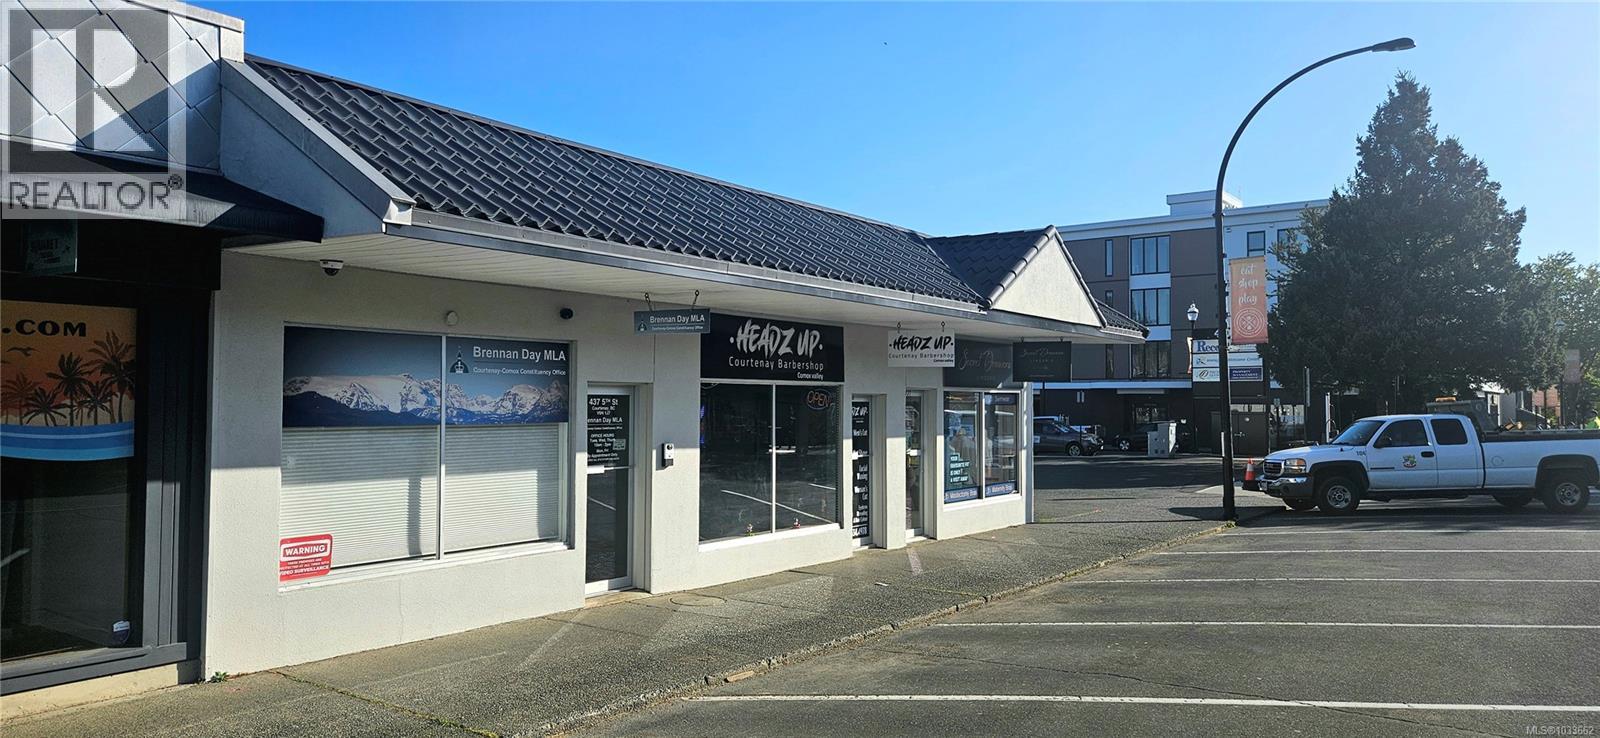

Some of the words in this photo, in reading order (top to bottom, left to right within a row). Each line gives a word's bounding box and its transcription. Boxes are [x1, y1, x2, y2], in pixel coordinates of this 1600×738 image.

[676, 315, 690, 324] Day
[797, 328, 821, 359] UP
[933, 335, 952, 350] UP
[472, 345, 519, 360] Brennan
[521, 348, 541, 363] Day
[543, 349, 566, 361] MLA
[728, 356, 775, 371] Courtenay
[777, 358, 824, 371] Barbershop
[472, 366, 519, 375] Courtenay-Comox
[519, 368, 552, 377] Constituency
[285, 544, 326, 556] WARNING
